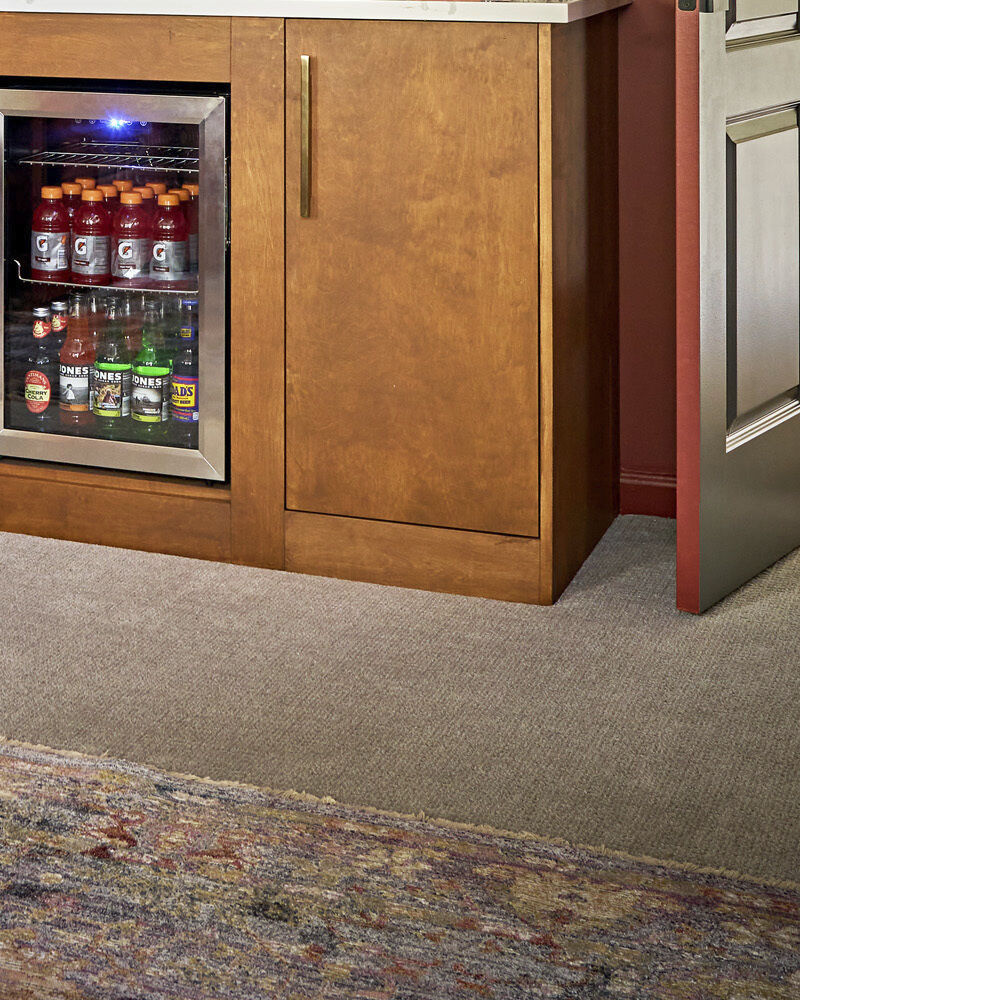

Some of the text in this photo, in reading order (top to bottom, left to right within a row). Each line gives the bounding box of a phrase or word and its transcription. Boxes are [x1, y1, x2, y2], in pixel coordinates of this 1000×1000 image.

[36, 236, 48, 252] G
[75, 238, 86, 255] G
[118, 242, 132, 258] G
[153, 244, 166, 260] G
[94, 372, 121, 380] ONES
